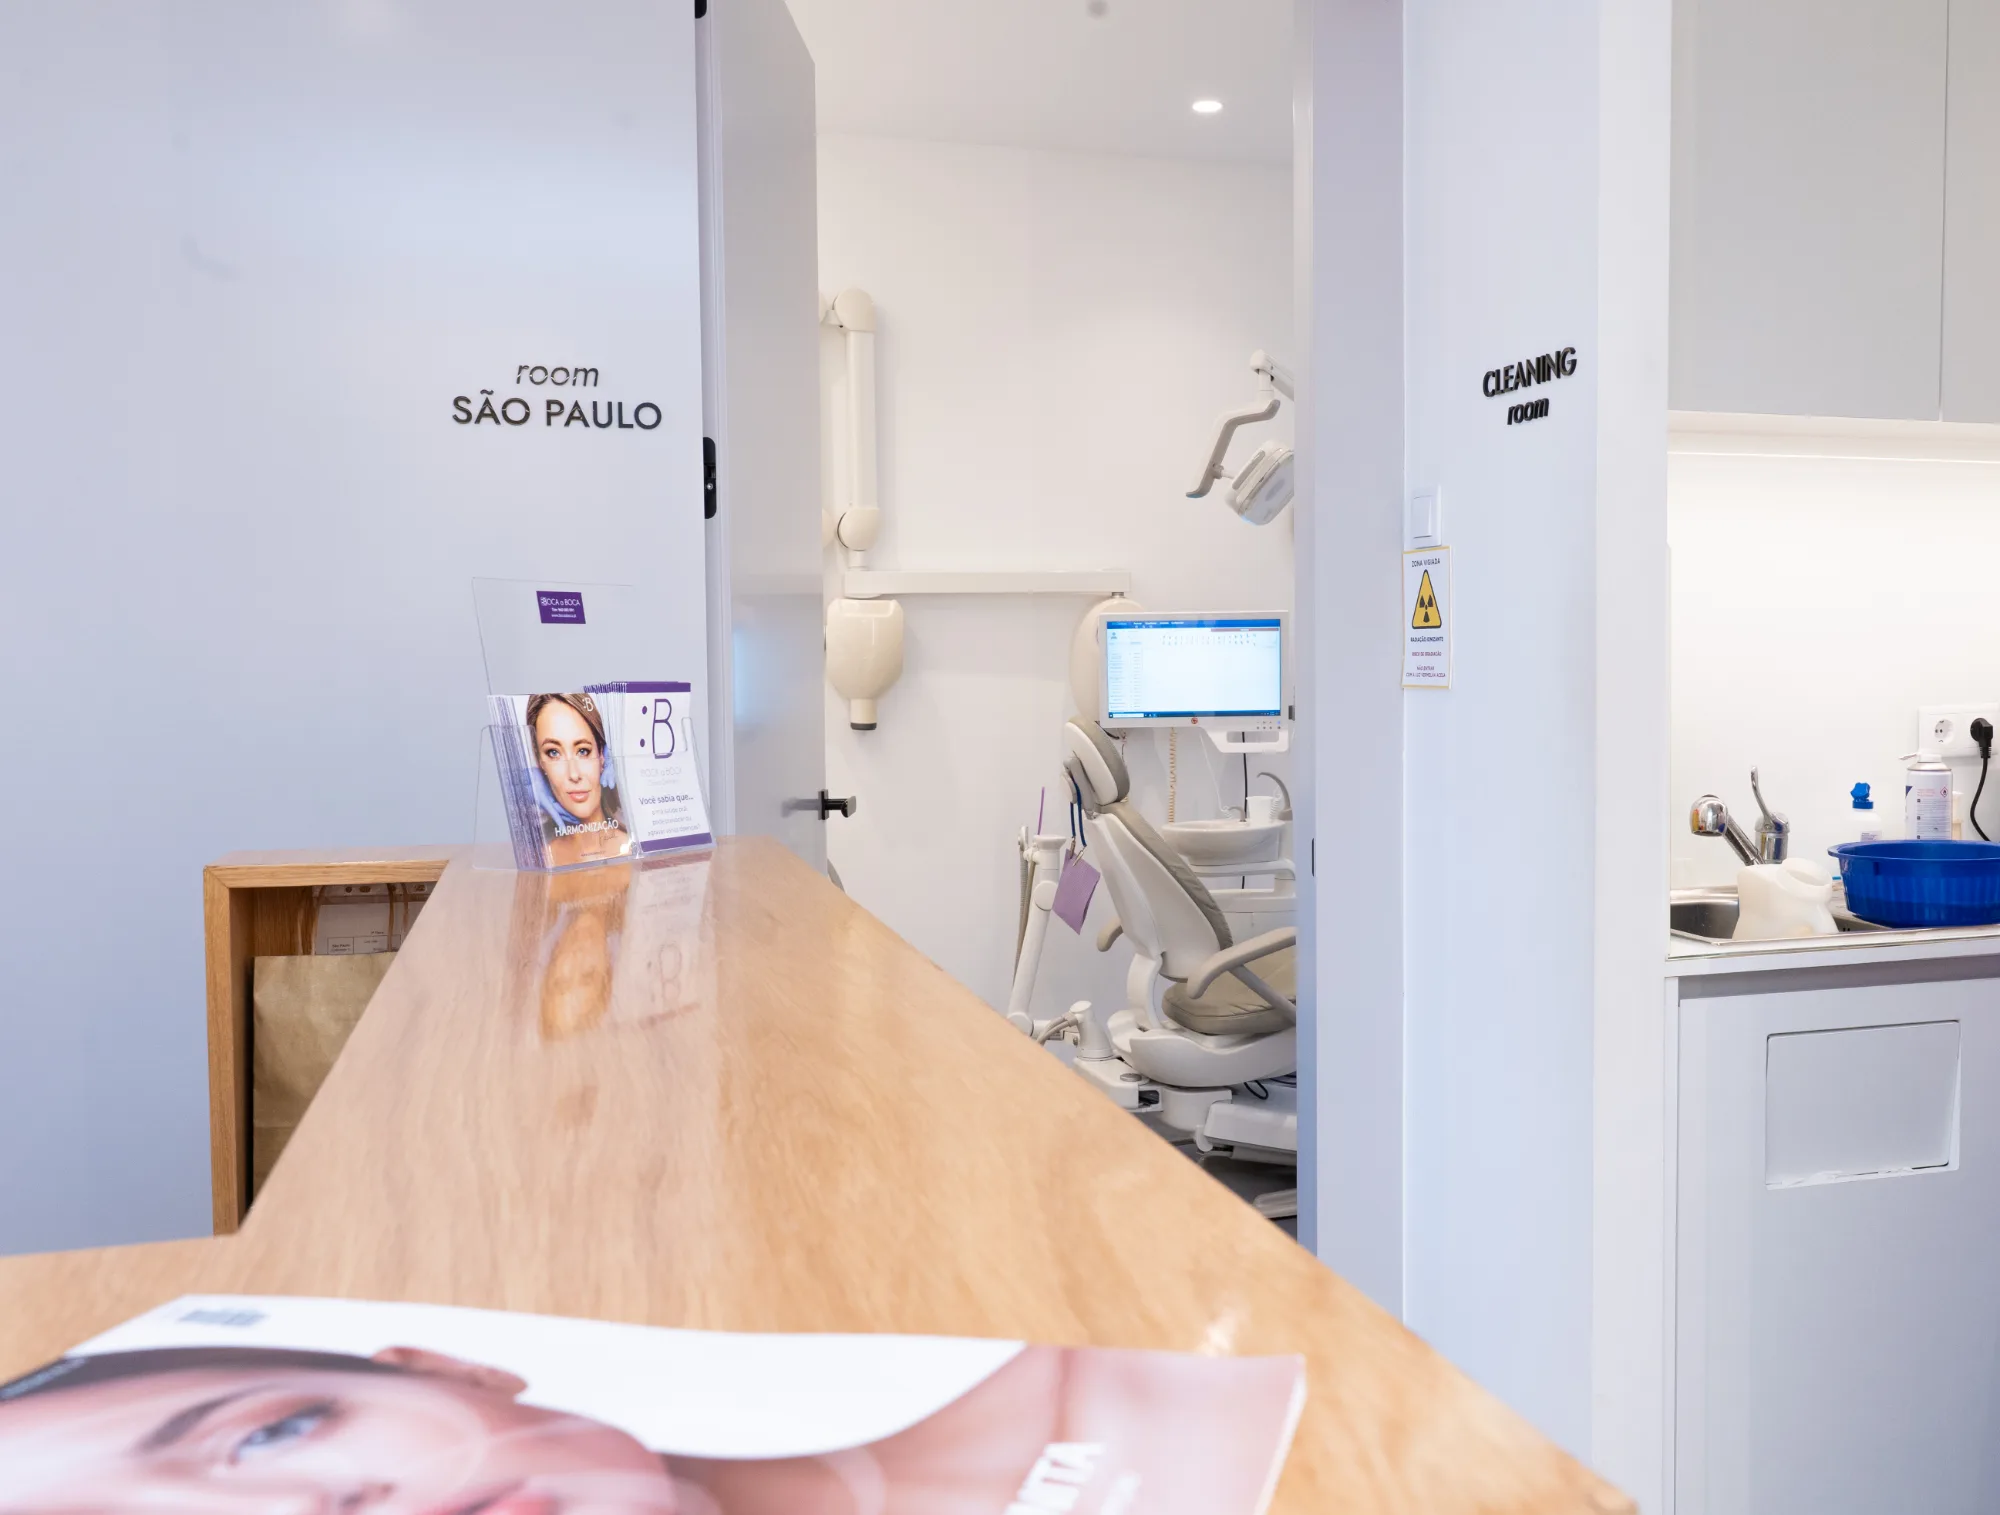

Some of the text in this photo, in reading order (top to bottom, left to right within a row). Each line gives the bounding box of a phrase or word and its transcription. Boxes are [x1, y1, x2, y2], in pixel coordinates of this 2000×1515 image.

[516, 364, 599, 387] room
[1482, 346, 1577, 397] CLEANING
[452, 388, 662, 430] SÃO PAULO
[1506, 398, 1549, 425] room
[639, 795, 656, 805] Você
[657, 794, 675, 803] sabia
[554, 817, 619, 837] HARMONIZAÇÃO
